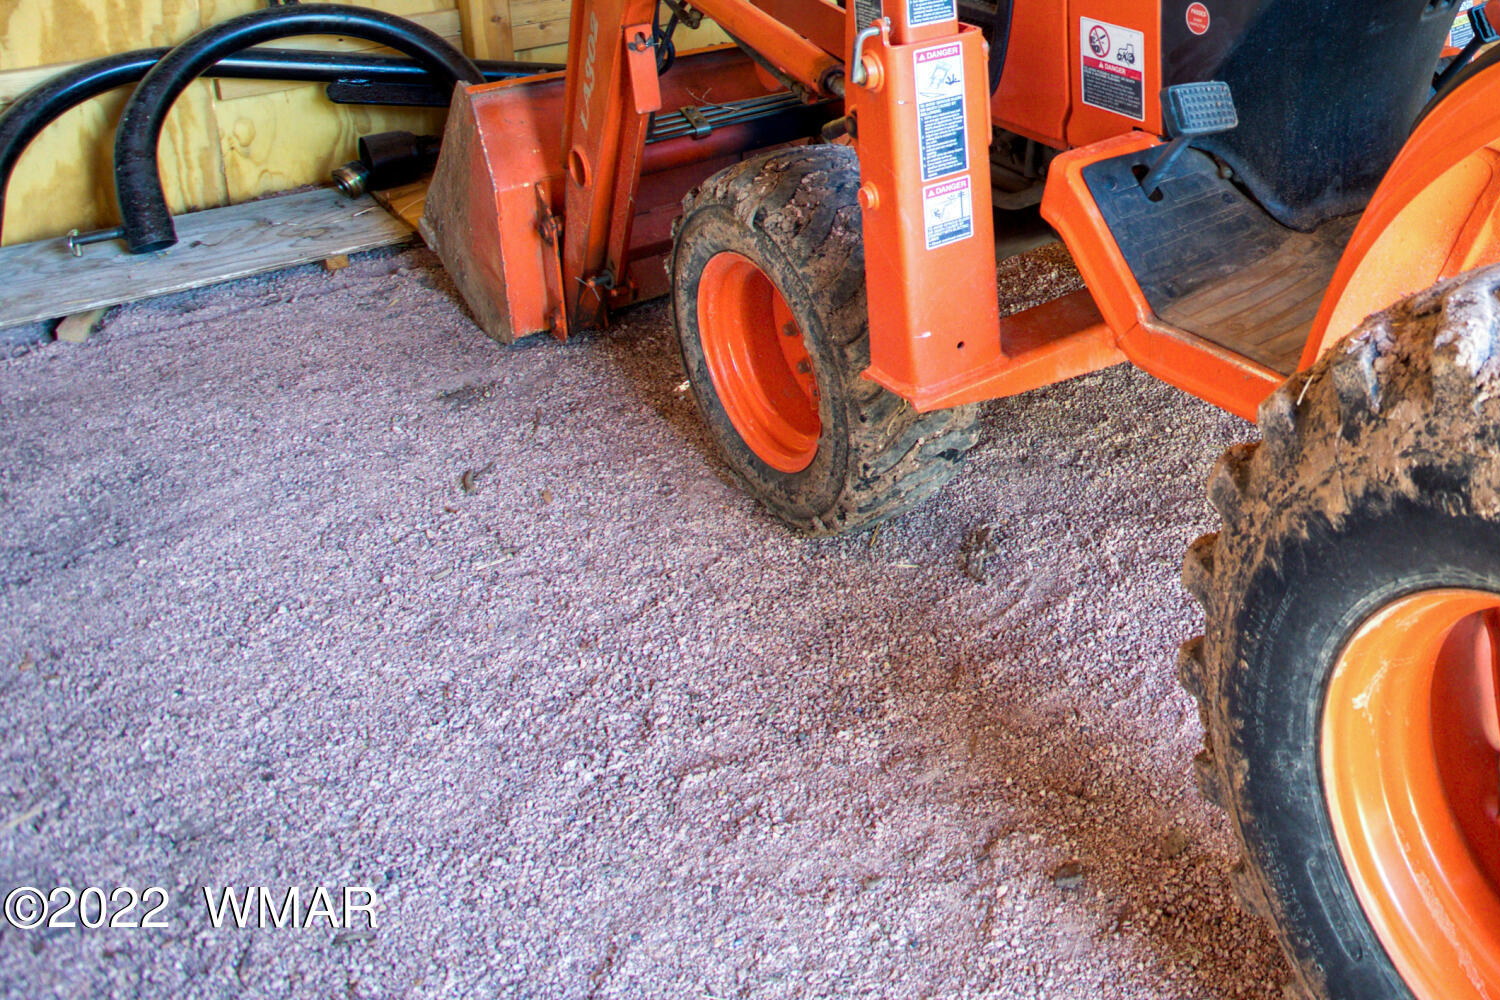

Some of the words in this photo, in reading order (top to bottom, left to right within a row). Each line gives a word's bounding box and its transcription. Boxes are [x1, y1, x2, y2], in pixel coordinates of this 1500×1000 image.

[926, 46, 958, 60] DANGER
[1105, 62, 1126, 75] DANGER
[935, 180, 967, 195] DANGER
